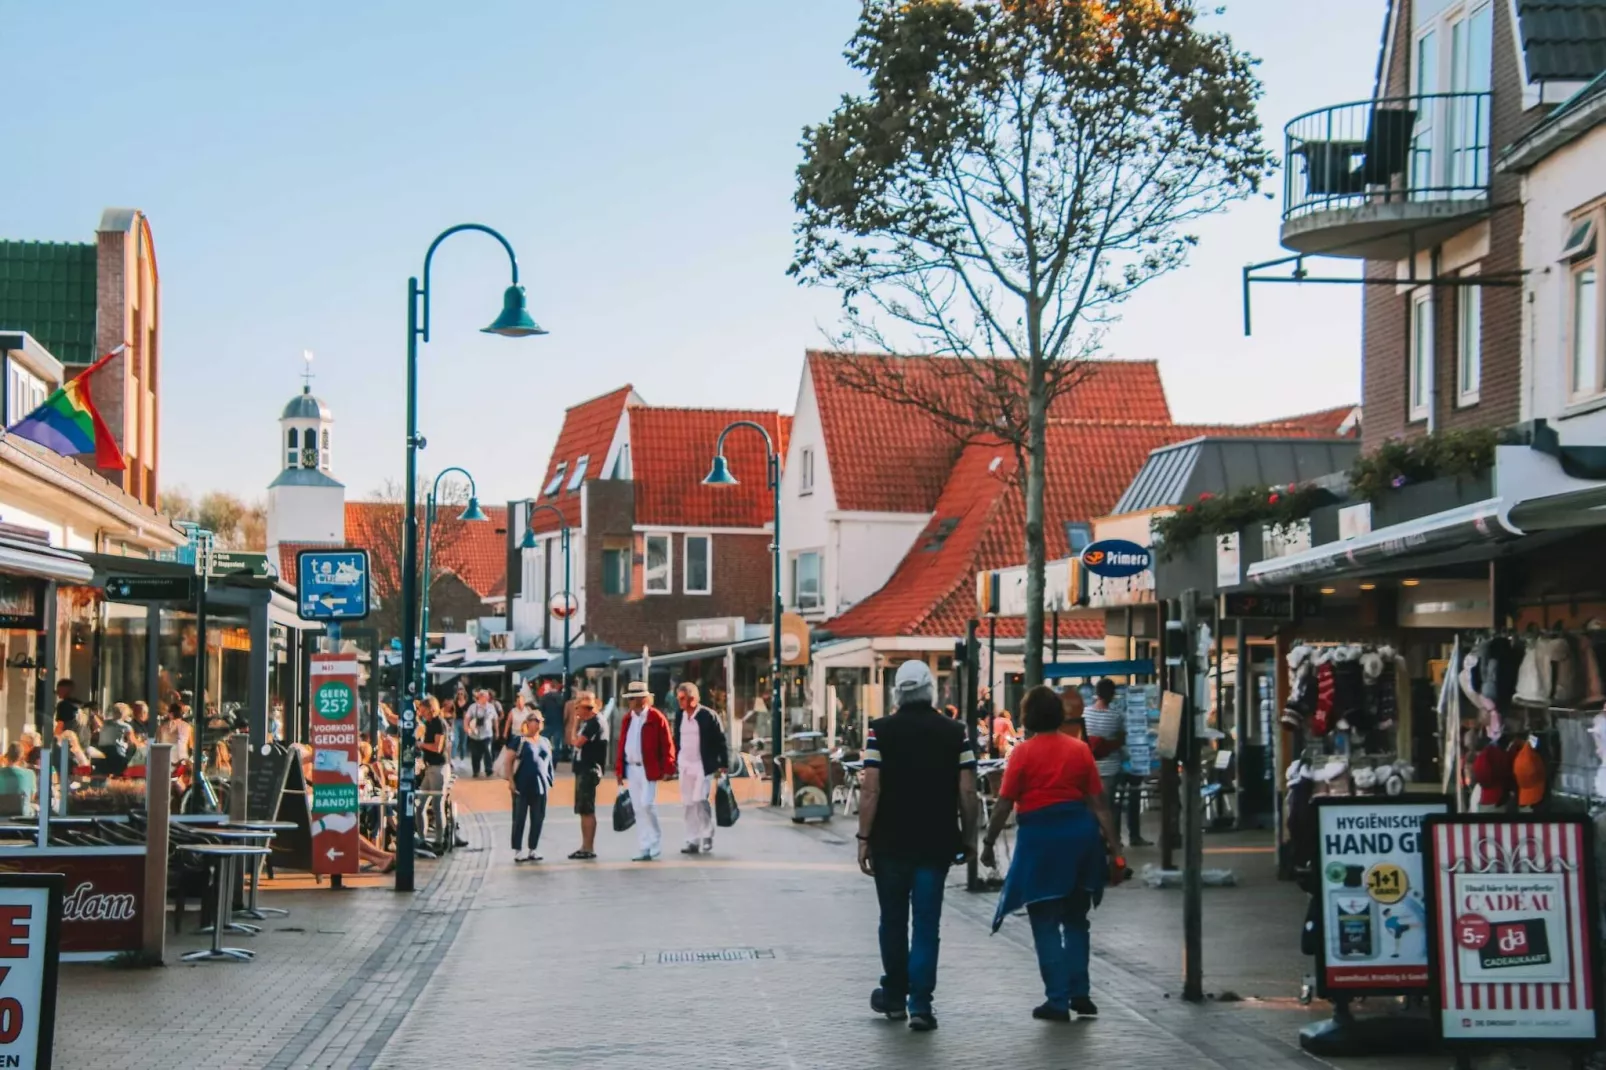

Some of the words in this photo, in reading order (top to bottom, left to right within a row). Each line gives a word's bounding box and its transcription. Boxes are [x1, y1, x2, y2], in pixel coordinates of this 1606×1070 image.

[1107, 551, 1148, 566] Primera
[320, 689, 348, 698] GEEN
[320, 699, 348, 713] 25?
[314, 724, 354, 732] VOORKOM
[339, 788, 354, 796] EEN
[315, 798, 356, 809] BANDJE
[1325, 832, 1394, 855] HAND
[1372, 869, 1399, 887] 1+1
[1465, 894, 1556, 911] CADEAU
[1500, 929, 1526, 951] da
[1484, 954, 1548, 967] CADEAUKAART
